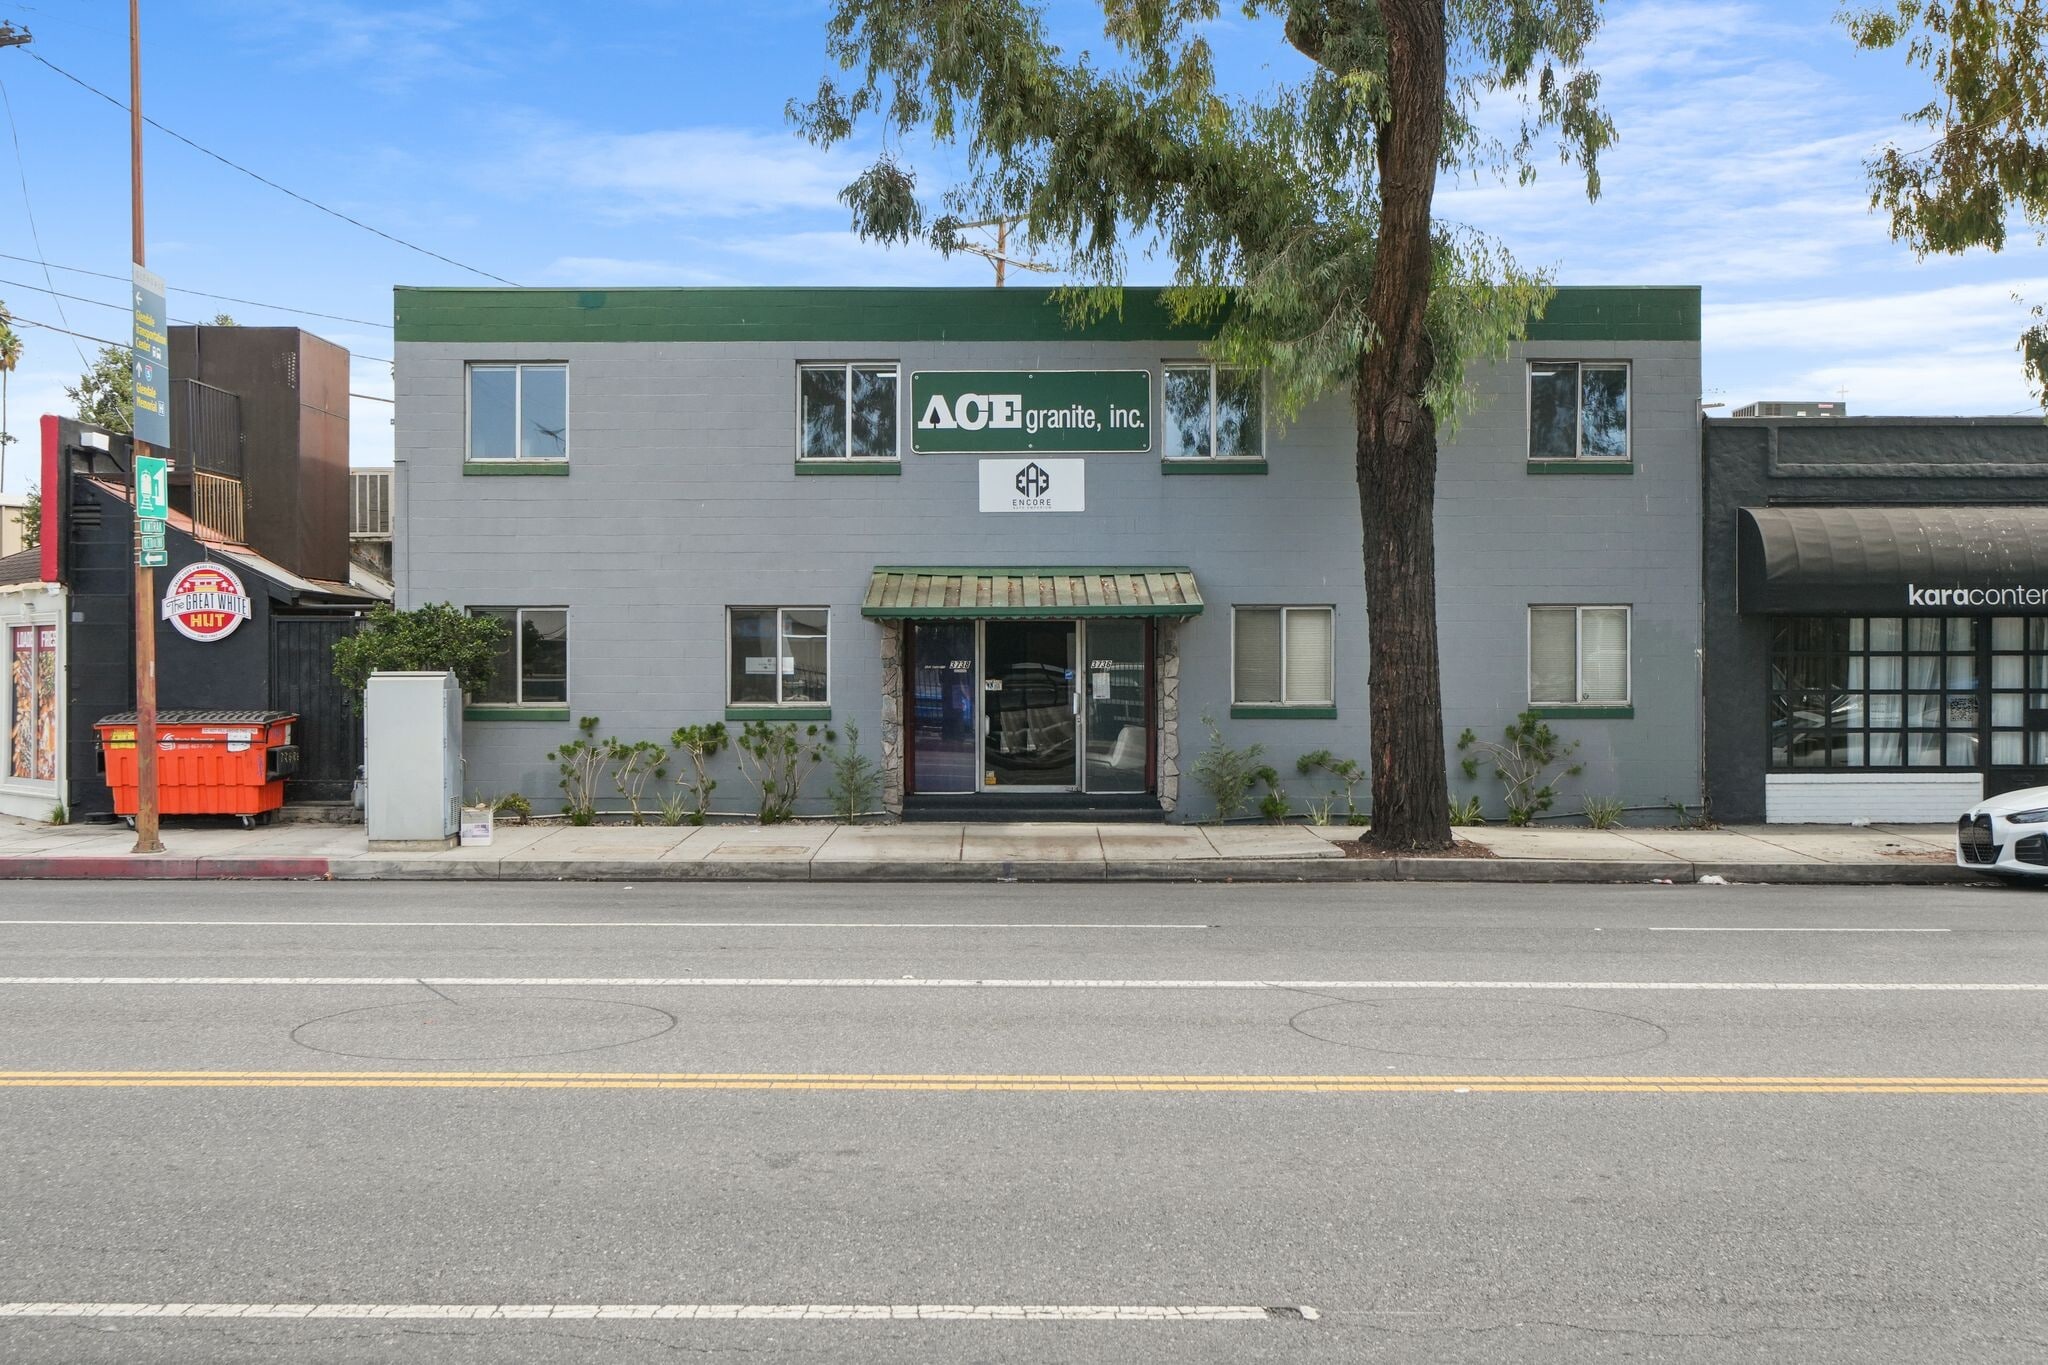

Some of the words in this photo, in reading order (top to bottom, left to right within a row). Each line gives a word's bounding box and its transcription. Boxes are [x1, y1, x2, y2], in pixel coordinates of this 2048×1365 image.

[136, 309, 155, 328] Glendale
[136, 337, 151, 352] Center
[136, 382, 156, 399] Glendale
[917, 393, 1022, 431] ACE
[1025, 404, 1102, 434] granite,
[1109, 404, 1145, 428] inc.
[1012, 498, 1052, 506] ENCORE
[166, 599, 185, 614] The
[186, 593, 214, 610] GREAT
[217, 593, 246, 615] WHITE
[190, 613, 225, 627] HUT
